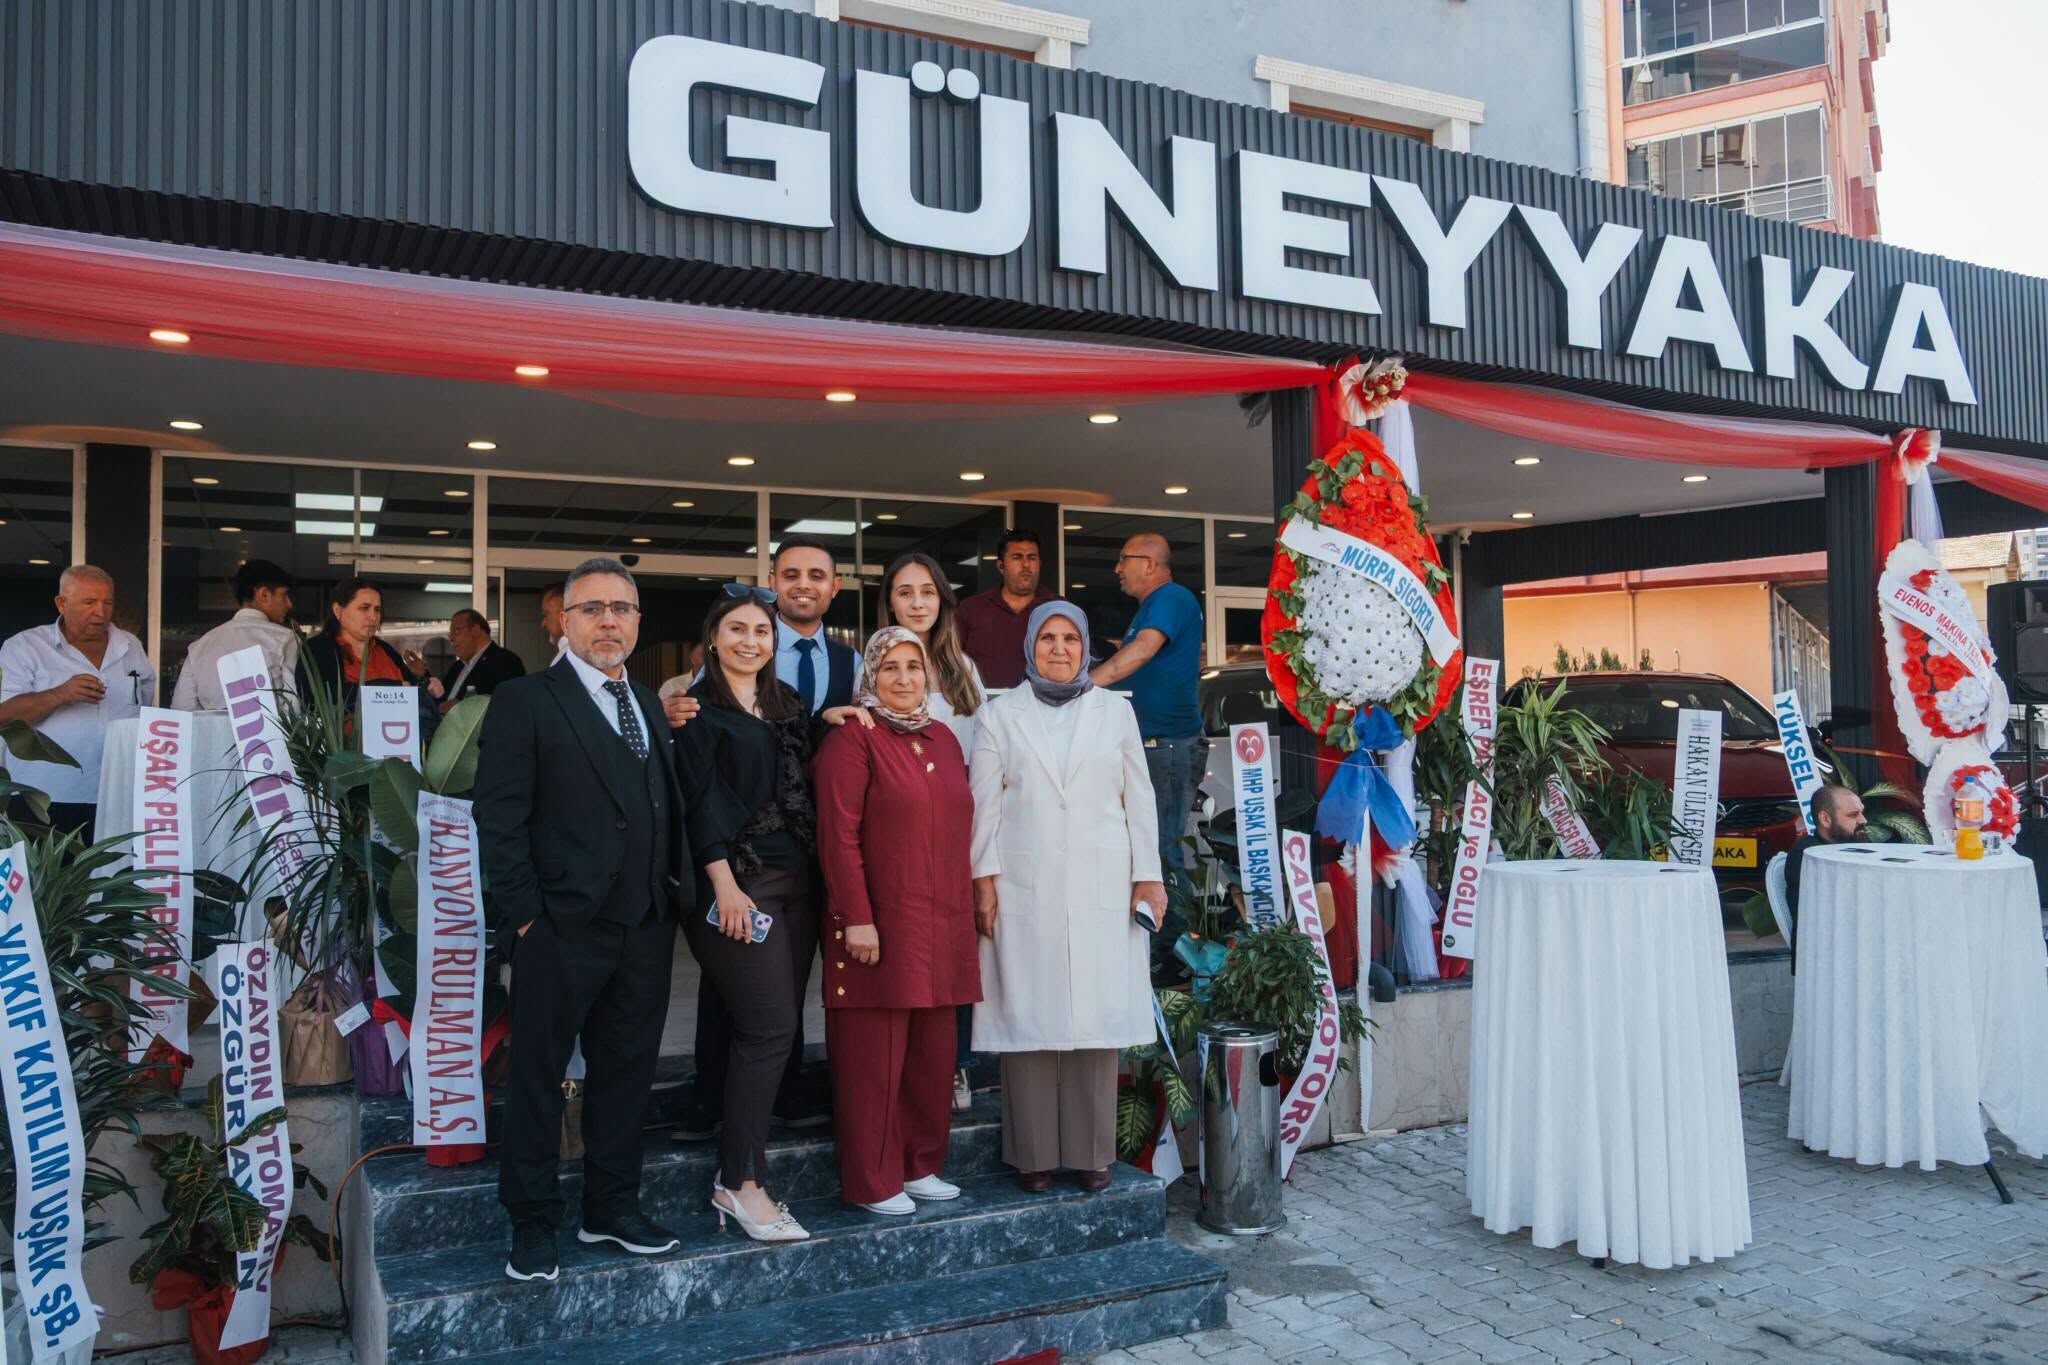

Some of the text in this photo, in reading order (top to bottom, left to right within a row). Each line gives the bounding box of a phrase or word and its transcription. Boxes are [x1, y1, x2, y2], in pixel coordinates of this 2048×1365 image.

[628, 35, 1977, 405] GÜNEYYAKA
[1340, 545, 1435, 636] MÜRPA SİGORTA
[1894, 588, 1936, 617] EVENOS
[375, 691, 405, 699] No:14
[140, 719, 180, 794] UŞAK
[1241, 767, 1264, 793] MHP
[1686, 735, 1710, 788] HAKAN
[1776, 695, 1815, 790] YÜKSEL
[1239, 797, 1266, 831] UŞAK
[1463, 835, 1480, 859] ve
[429, 819, 479, 938] KANYON
[0, 923, 47, 1032] VAKIF
[246, 947, 274, 1101] ÖZAYDIN
[427, 947, 478, 1079] RULMAN
[14, 1040, 71, 1191] KATILIM
[221, 964, 258, 1292] ÖZGÜR AYN
[416, 1086, 478, 1141] A.Ş.
[18, 1188, 70, 1287] UŞAK
